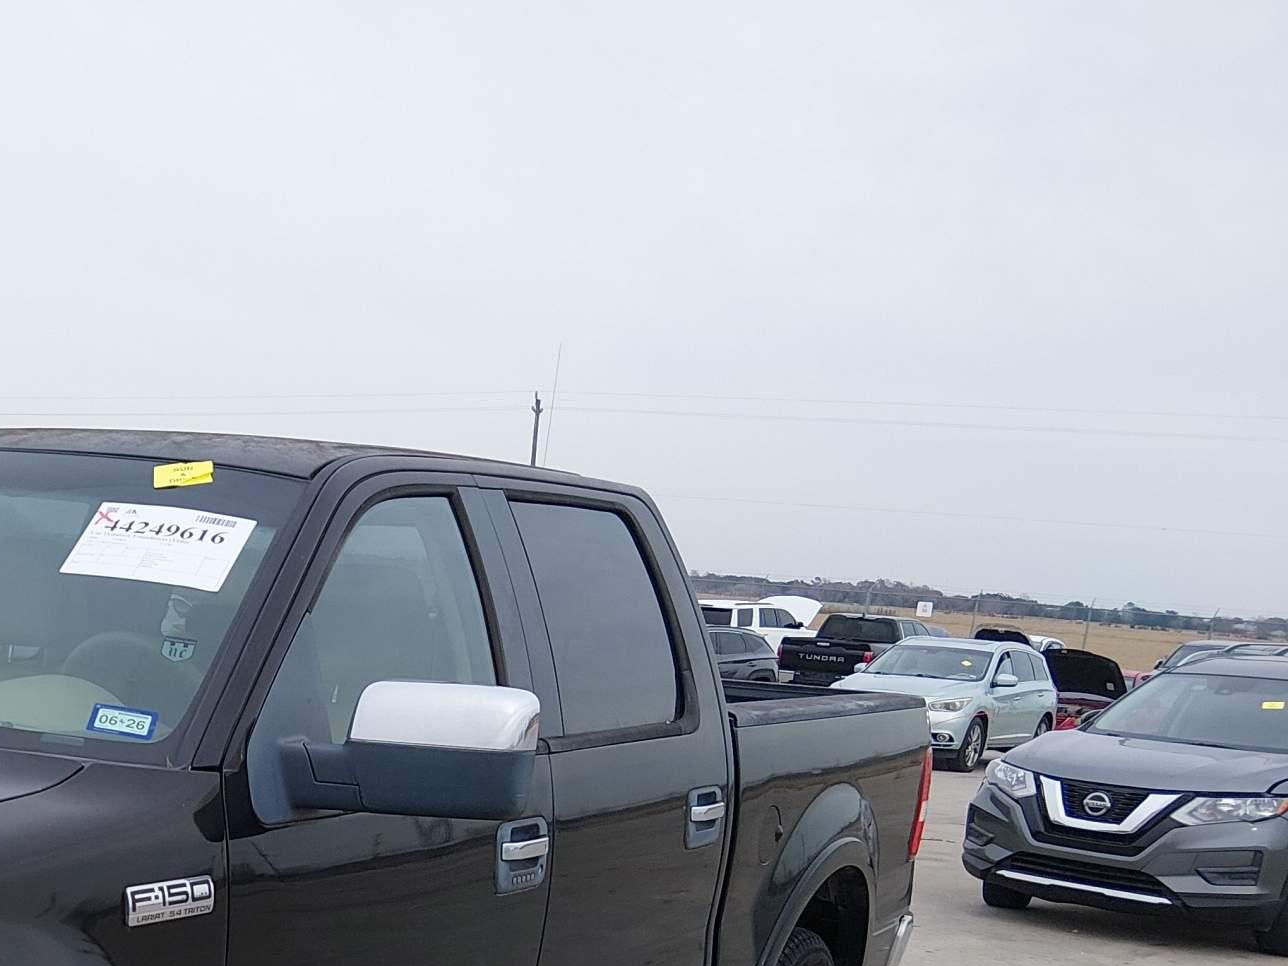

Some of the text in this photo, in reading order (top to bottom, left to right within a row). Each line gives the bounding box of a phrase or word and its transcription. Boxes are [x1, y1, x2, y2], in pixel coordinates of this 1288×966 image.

[104, 519, 230, 544] 44249616
[798, 653, 845, 663] TUNDRA
[130, 879, 212, 912] F-150
[136, 911, 165, 923] LARIAT
[183, 904, 212, 915] TRITON
